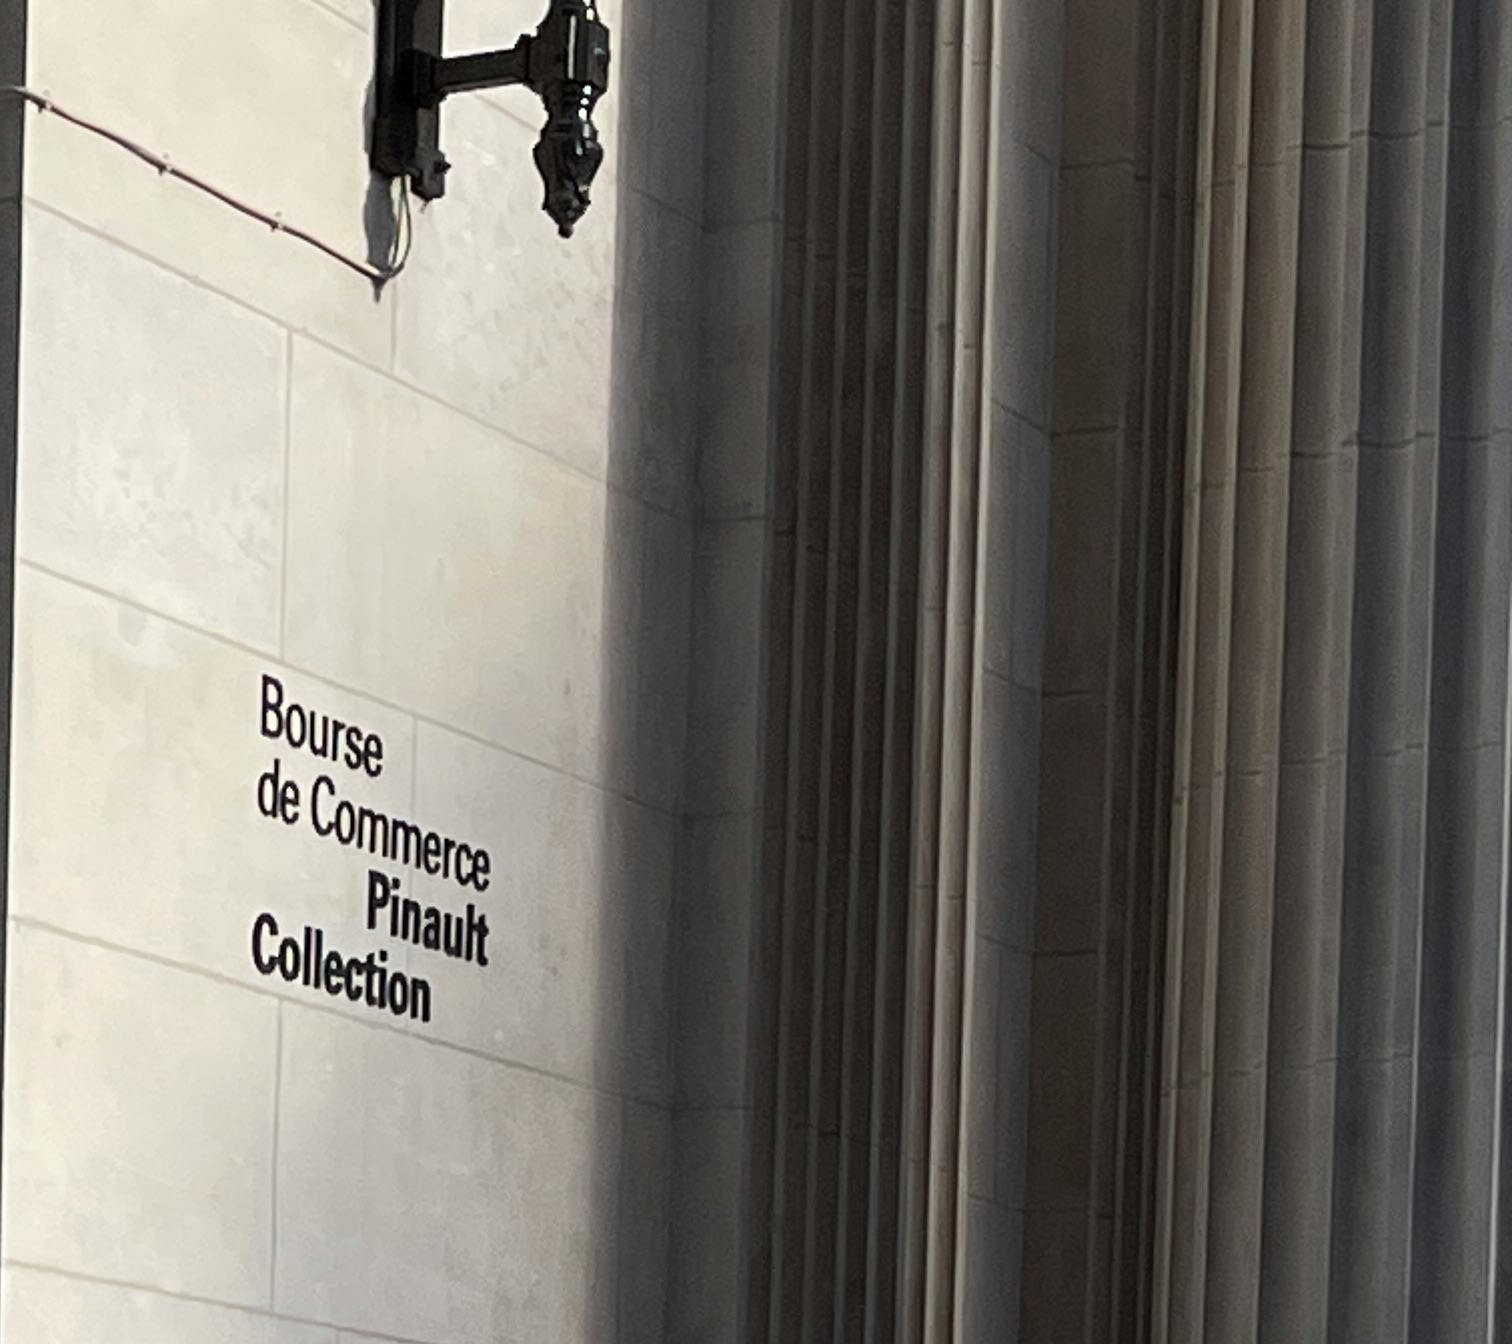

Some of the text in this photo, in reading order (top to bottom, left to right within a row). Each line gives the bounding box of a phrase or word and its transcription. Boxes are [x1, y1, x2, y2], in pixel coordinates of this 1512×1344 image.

[261, 674, 383, 777] Bourse
[258, 758, 490, 891] de Commerce
[252, 913, 431, 1023] Collection
[367, 870, 489, 967] Pinault
